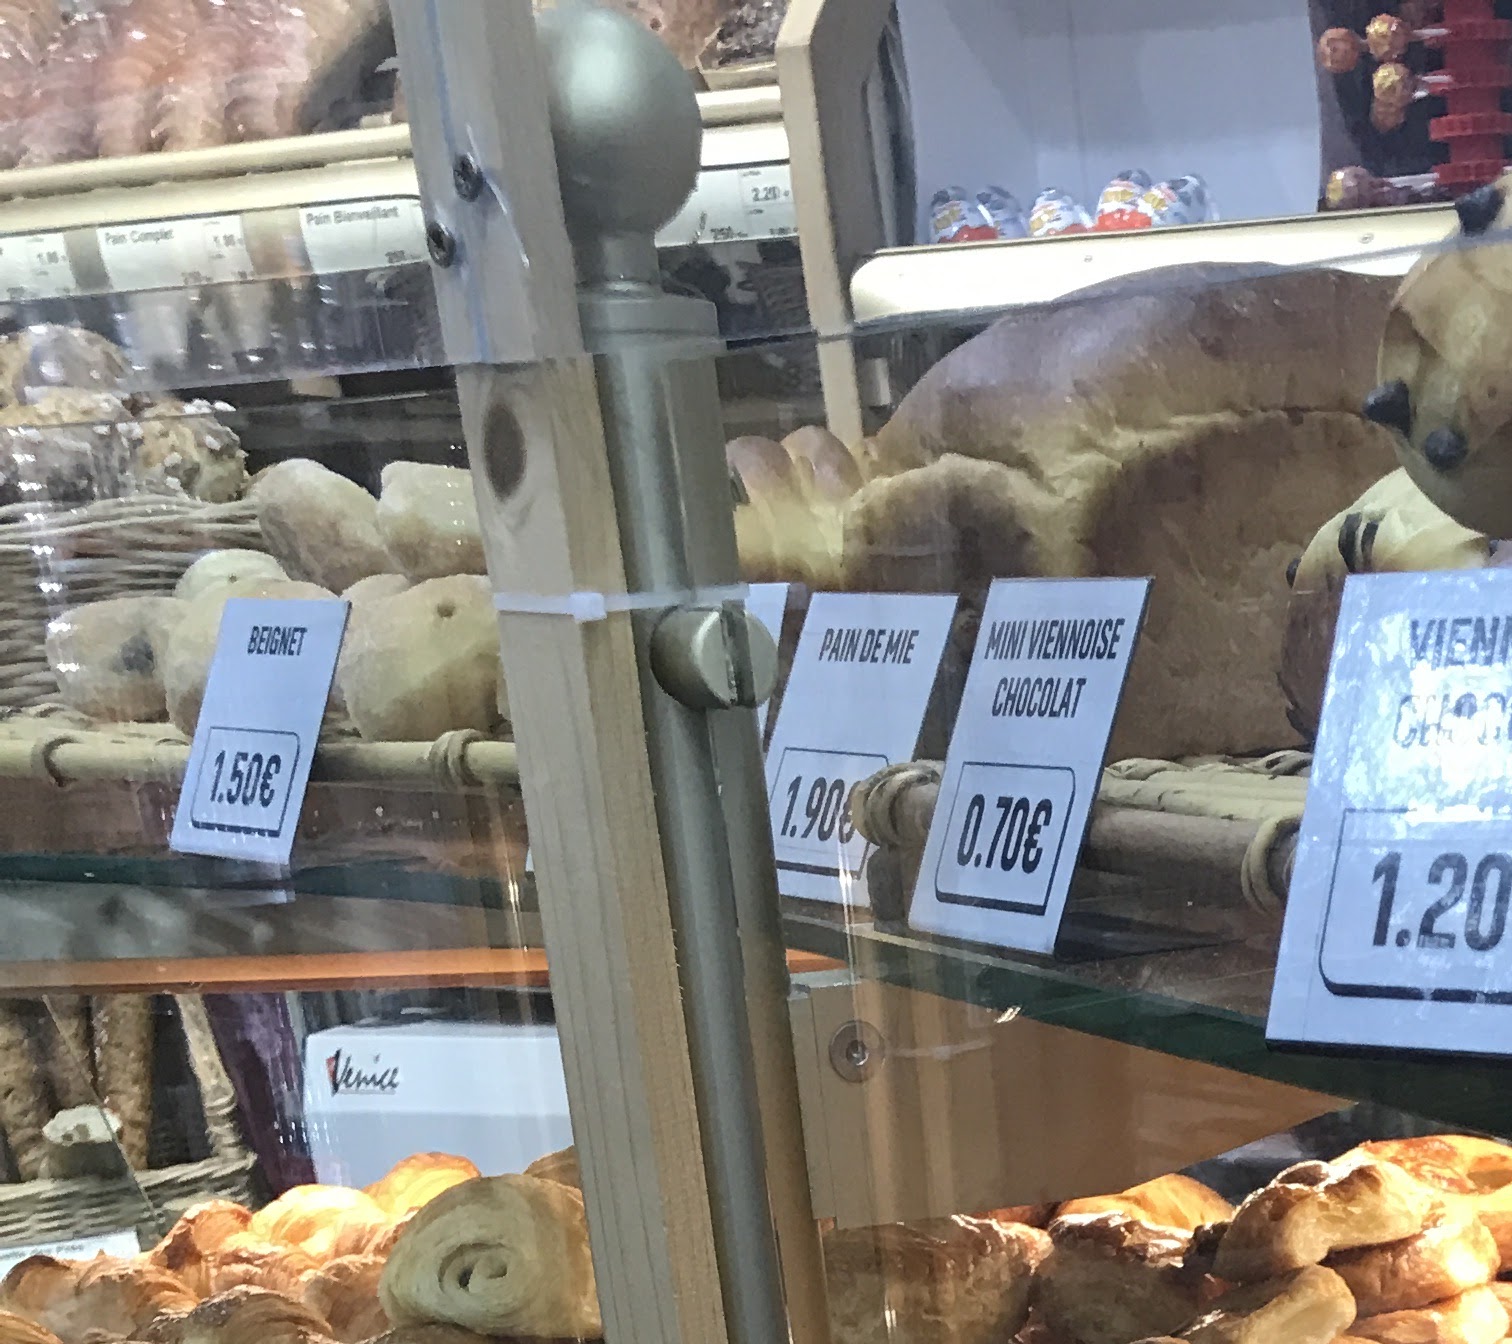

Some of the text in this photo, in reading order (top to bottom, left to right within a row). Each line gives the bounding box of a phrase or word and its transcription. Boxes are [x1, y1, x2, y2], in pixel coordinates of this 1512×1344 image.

[248, 625, 308, 657] BEIGNET
[818, 628, 919, 664] PAIN DE MIE
[984, 618, 1125, 660] MINI VIENNOISE
[991, 676, 1087, 719] CHOCOLAT
[210, 748, 282, 808] 1.50€
[957, 793, 1053, 875] 0.70€
